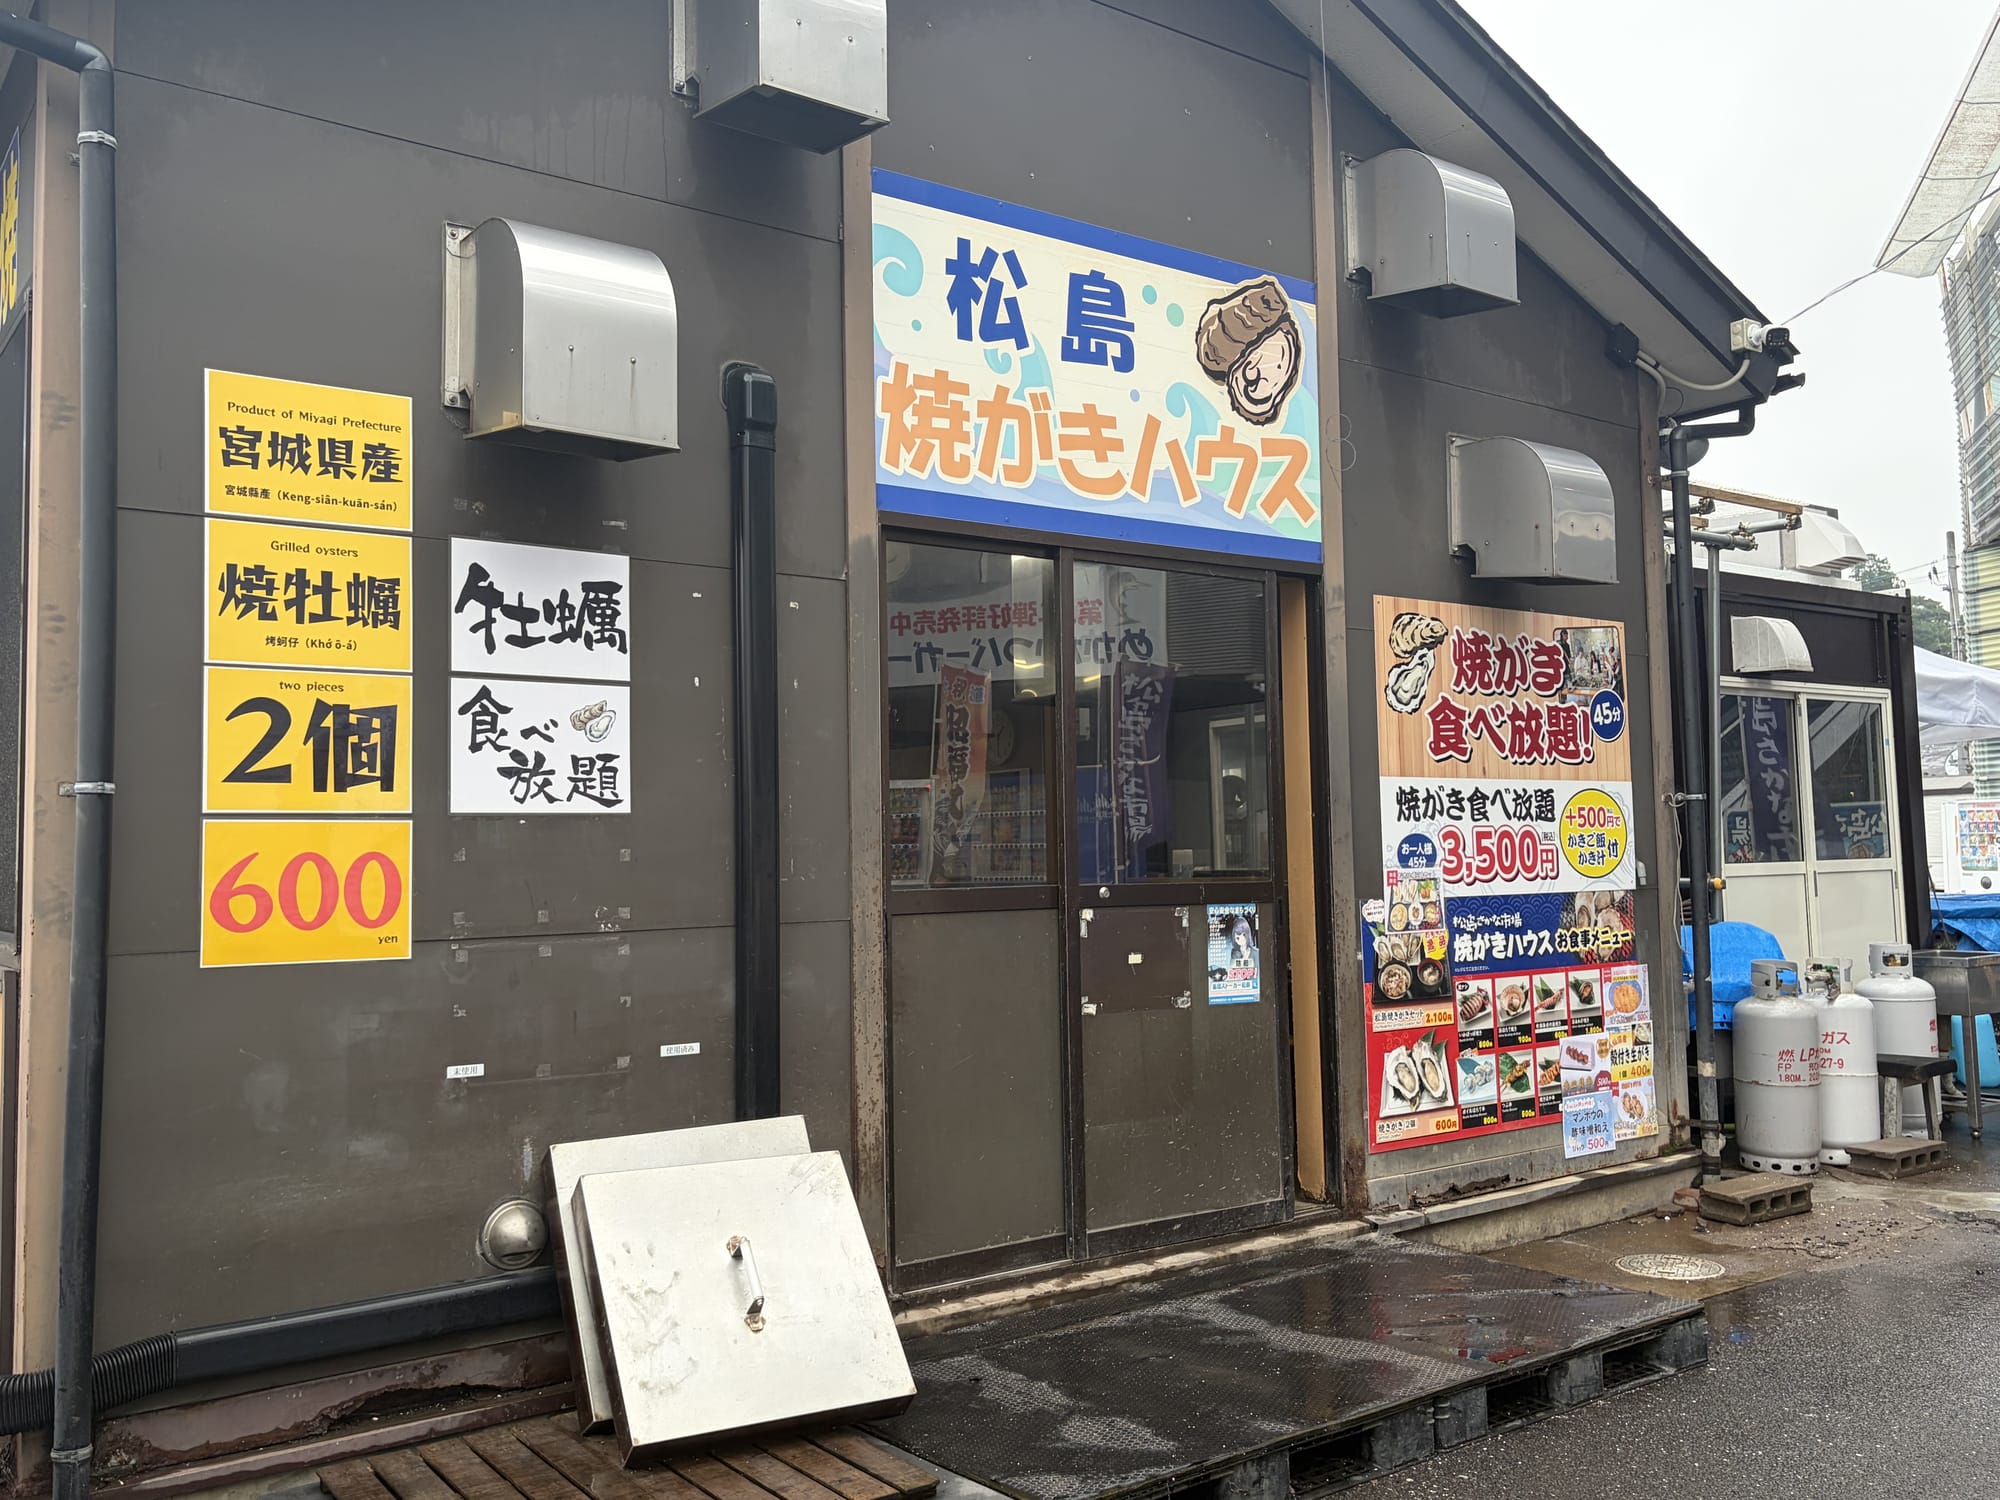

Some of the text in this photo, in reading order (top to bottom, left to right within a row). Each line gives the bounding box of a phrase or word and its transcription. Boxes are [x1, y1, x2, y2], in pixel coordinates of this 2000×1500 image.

[945, 236, 1135, 373] 松島
[227, 401, 402, 433] Product of Miyagi Prefecture
[218, 425, 404, 483] 宮城県産
[881, 361, 1317, 525] 焼がきハウス
[271, 540, 359, 558] Grilled oysters
[218, 563, 401, 631] 焼牡蠣
[454, 562, 628, 654] 牡蠣
[1453, 627, 1565, 693] 焼がき
[279, 681, 344, 692] two pieces
[457, 684, 559, 754] 食べ
[1593, 701, 1621, 727] 45分
[222, 696, 398, 793] 2個
[496, 749, 625, 809] 放題
[1396, 785, 1556, 823] 焼がき食べ放題
[1401, 841, 1433, 855] お一人様
[1441, 826, 1559, 884] 3,500円
[1567, 832, 1606, 848] かきご飯
[1608, 839, 1620, 858] 付
[1408, 855, 1428, 868] 45分
[1578, 849, 1606, 866] かき汁
[209, 851, 402, 934] 600
[1452, 912, 1523, 932] 松島さかな市場
[378, 933, 398, 945] yen
[1453, 929, 1554, 962] 焼がきハウス
[1556, 929, 1631, 950] お食事メニュー
[1822, 1031, 1851, 1045] ガス
[1777, 1063, 1792, 1072] FP
